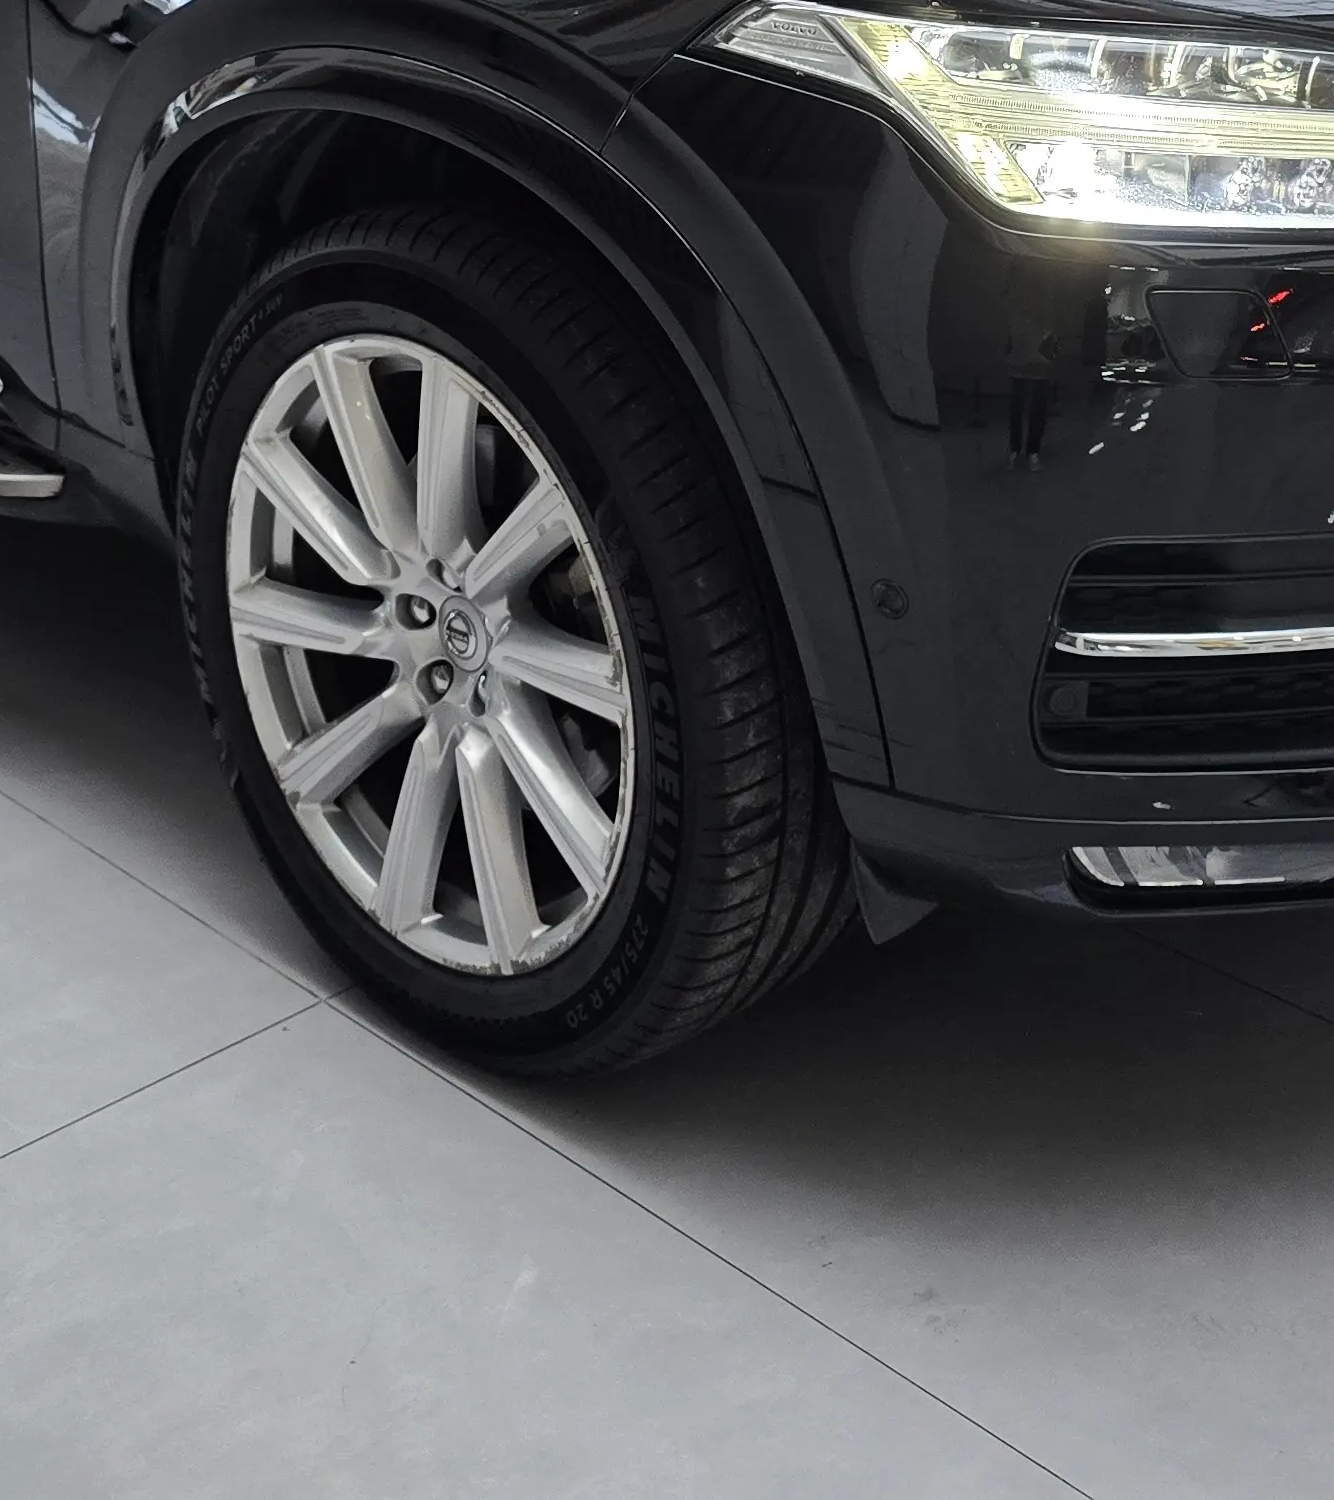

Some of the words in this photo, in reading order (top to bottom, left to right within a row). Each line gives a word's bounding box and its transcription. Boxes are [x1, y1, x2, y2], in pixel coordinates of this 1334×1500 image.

[770, 20, 818, 36] VOLVO
[628, 595, 680, 904] MICHELIN
[566, 1005, 588, 1029] 20
